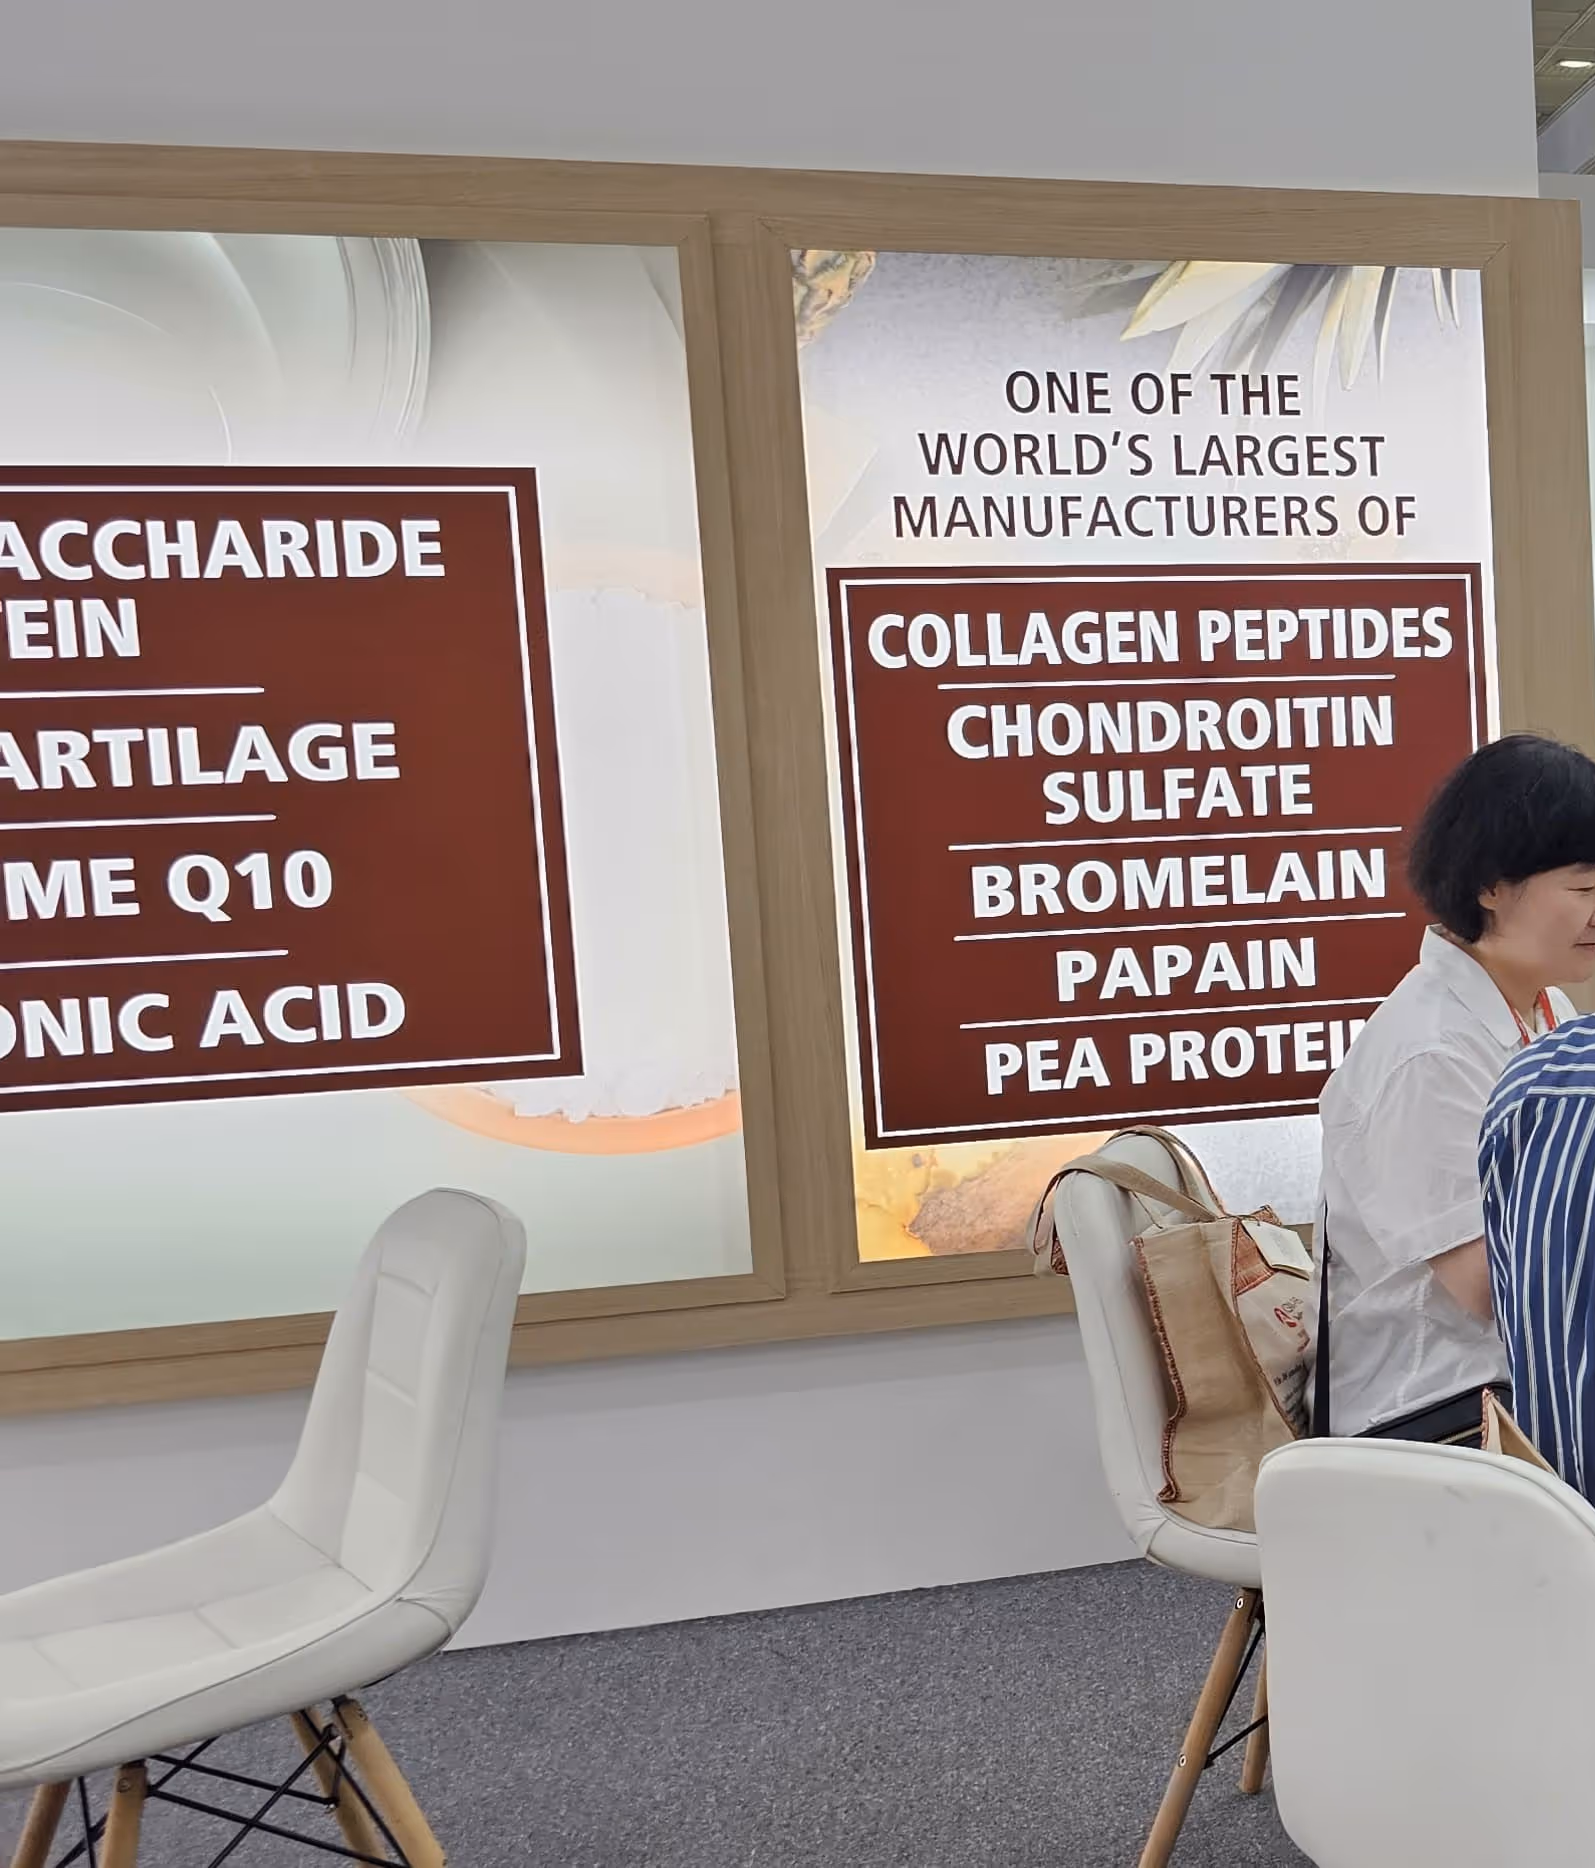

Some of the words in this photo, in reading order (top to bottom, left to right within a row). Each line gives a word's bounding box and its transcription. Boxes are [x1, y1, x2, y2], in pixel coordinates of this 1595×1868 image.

[1005, 371, 1110, 414] ONE
[1131, 373, 1193, 415] OF
[1210, 374, 1301, 416] THE
[918, 432, 1153, 476] WORLD'S
[1173, 435, 1385, 477] LARGEST
[893, 496, 1338, 538] MANUFACTURERS
[1358, 496, 1416, 537] OF
[0, 520, 445, 581] ACCHARIDE
[0, 598, 141, 659] EIN
[868, 611, 1180, 669] COLLAGEN
[1199, 606, 1453, 662] PEPTIDES
[0, 723, 401, 790] ARTILAGE
[946, 695, 1395, 758] CHONDROITIN
[1043, 764, 1313, 825] SULFATE
[3, 858, 141, 920] ME
[167, 850, 332, 922] Q10
[970, 848, 1386, 918] BROMELAIN
[1056, 937, 1317, 1002] PAPAIN
[0, 993, 174, 1059] NIC
[200, 982, 406, 1047] ACID
[985, 1037, 1111, 1095] PEA
